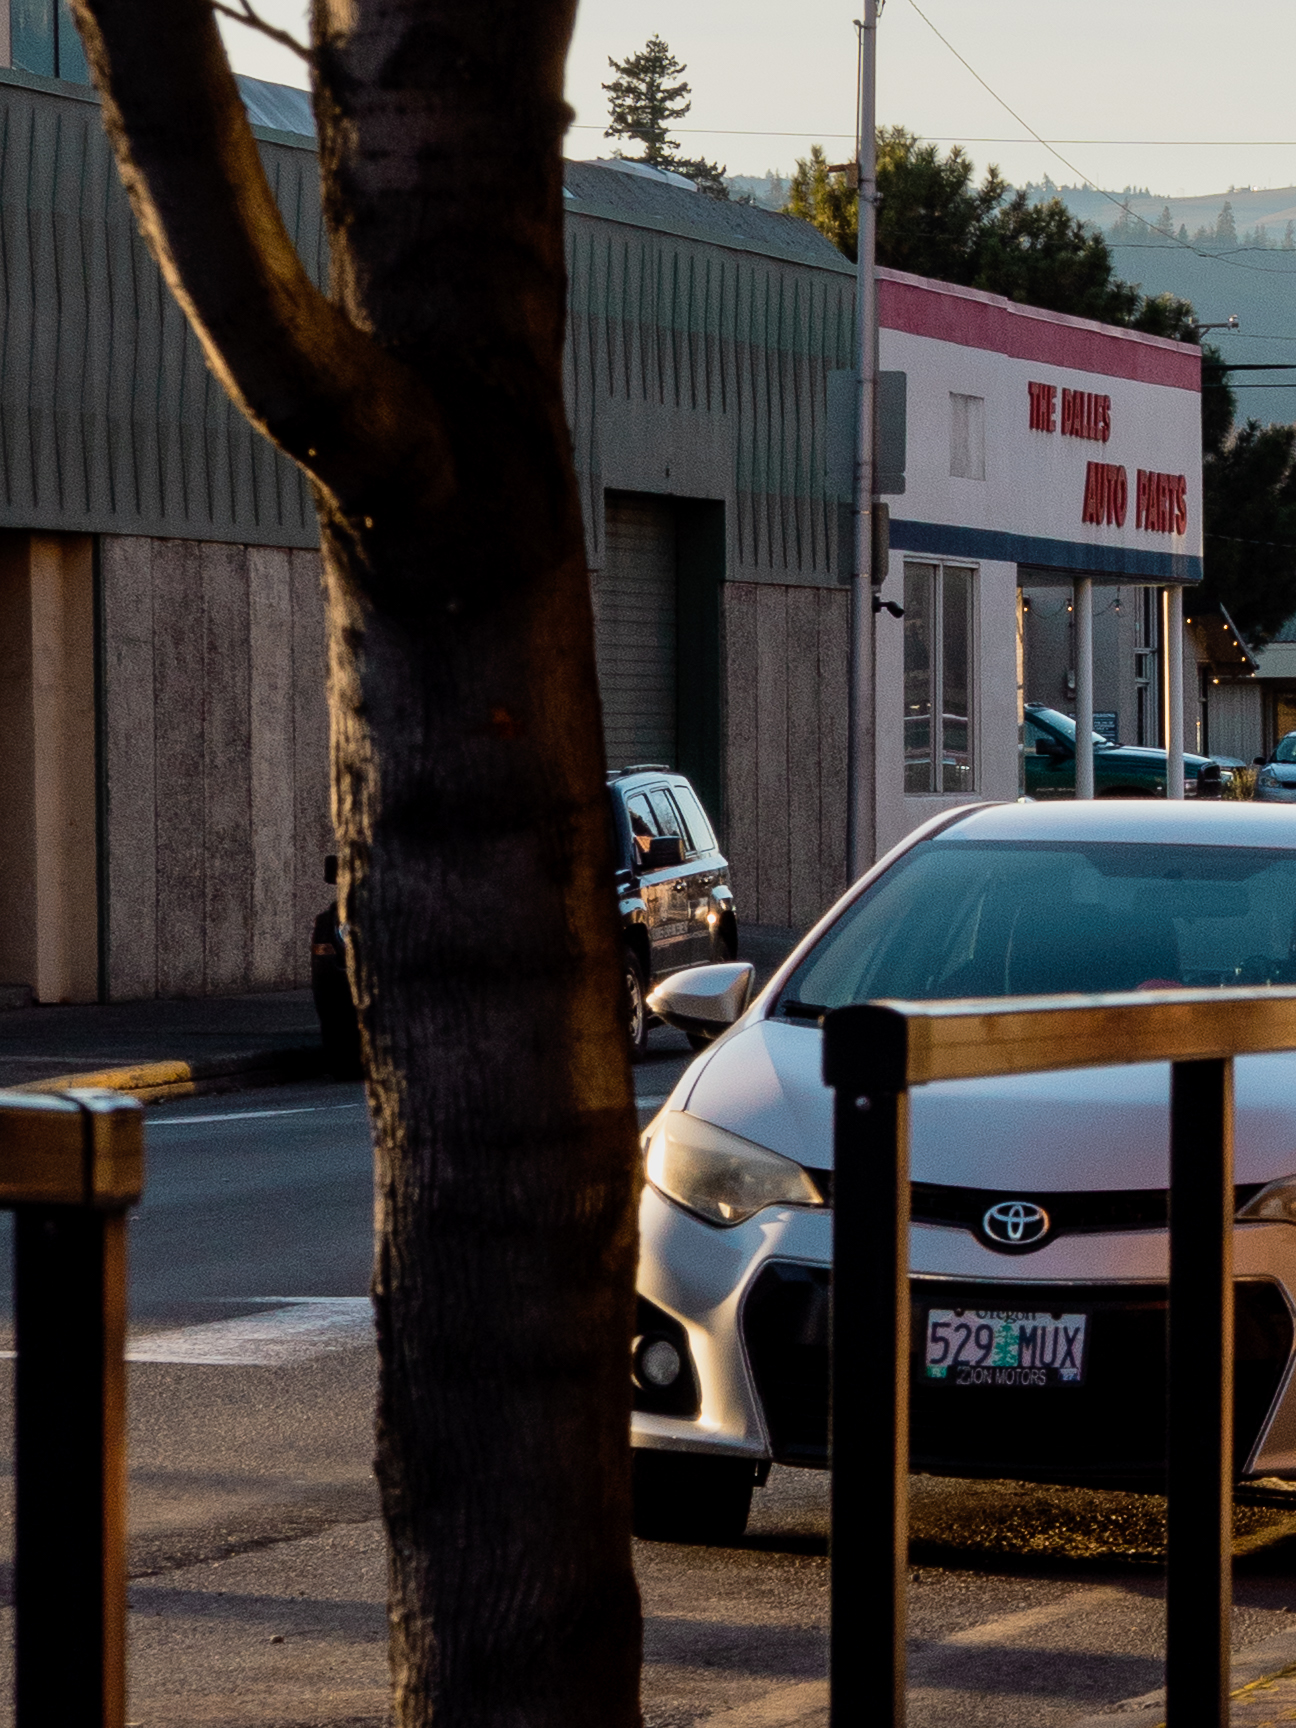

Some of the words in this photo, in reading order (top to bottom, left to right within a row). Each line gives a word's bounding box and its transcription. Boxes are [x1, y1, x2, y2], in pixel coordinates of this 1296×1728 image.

[1028, 381, 1057, 433] THE
[1061, 387, 1111, 443] DALLES
[1082, 461, 1128, 529] AUTO
[1136, 468, 1188, 536] PARTS
[929, 1322, 994, 1367] 529
[1018, 1324, 1081, 1368] MUX
[956, 1367, 992, 1385] ZION
[996, 1369, 1047, 1386] MOTORS
